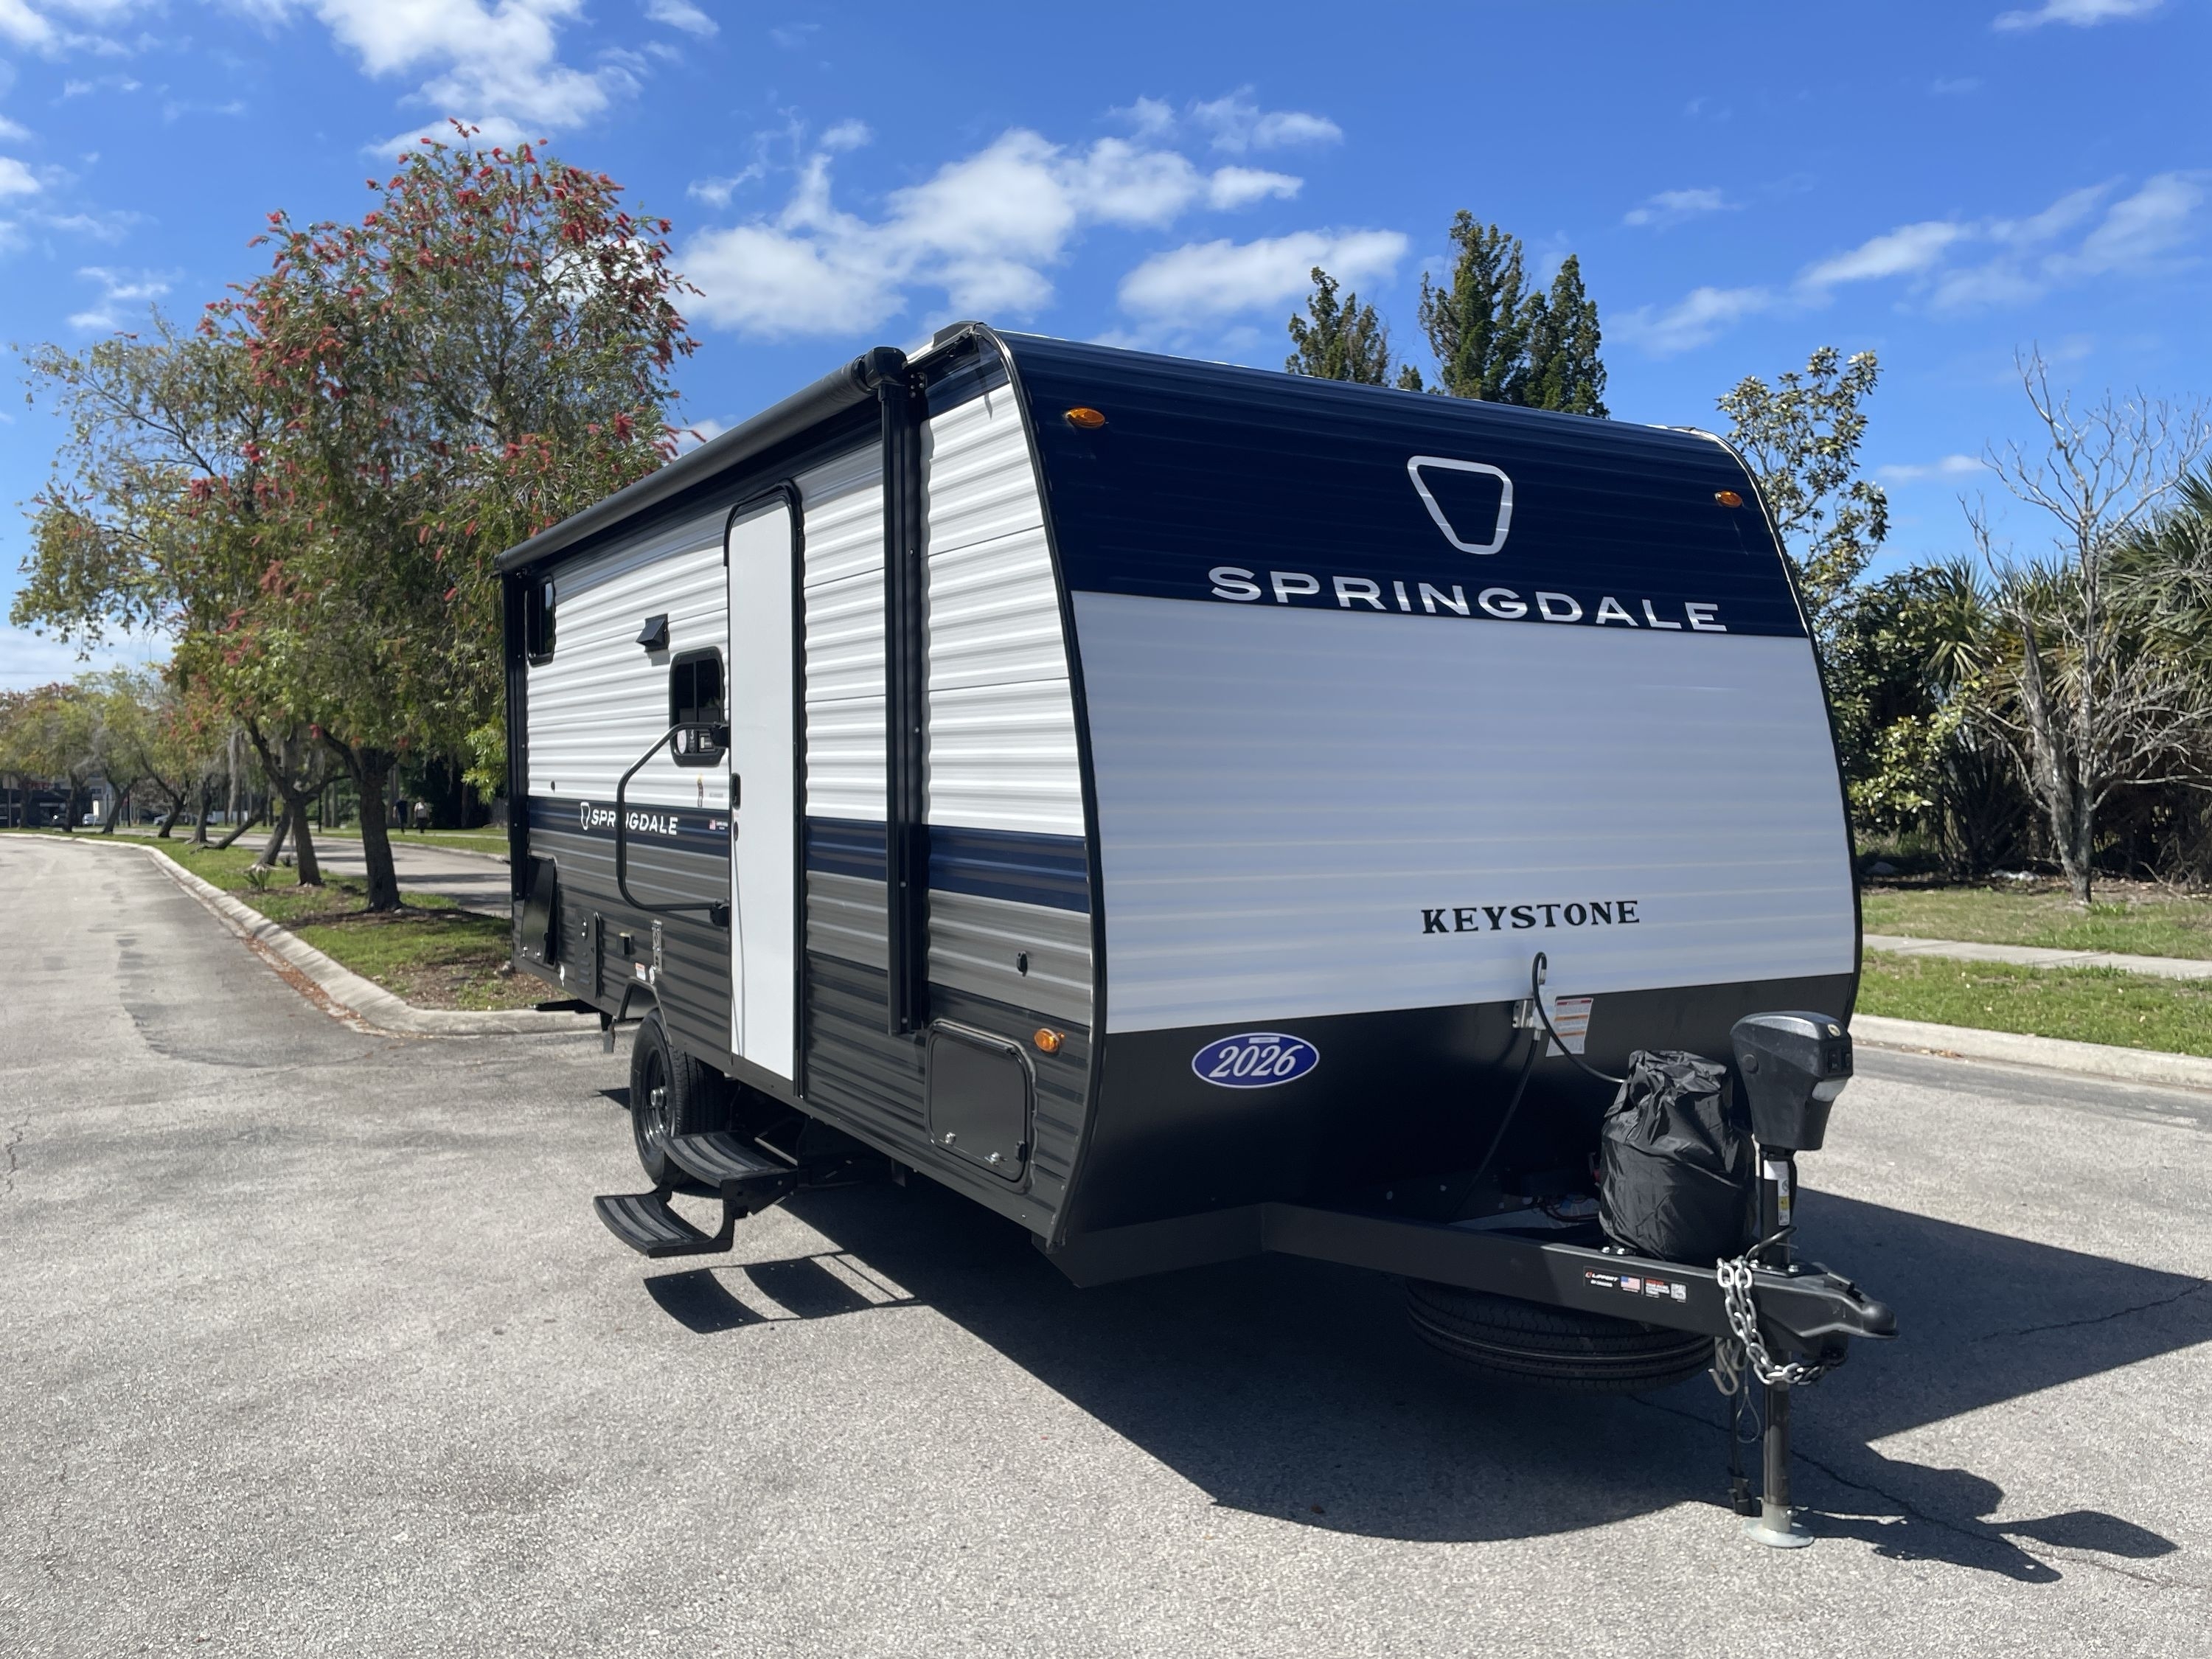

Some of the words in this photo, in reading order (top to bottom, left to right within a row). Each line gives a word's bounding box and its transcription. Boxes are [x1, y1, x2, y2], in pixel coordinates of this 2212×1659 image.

[1208, 566, 1728, 632] SPRINGDALE
[591, 808, 678, 835] SPRGDALE
[1420, 900, 1641, 934] KEYSTONE
[1208, 1044, 1304, 1078] 2026
